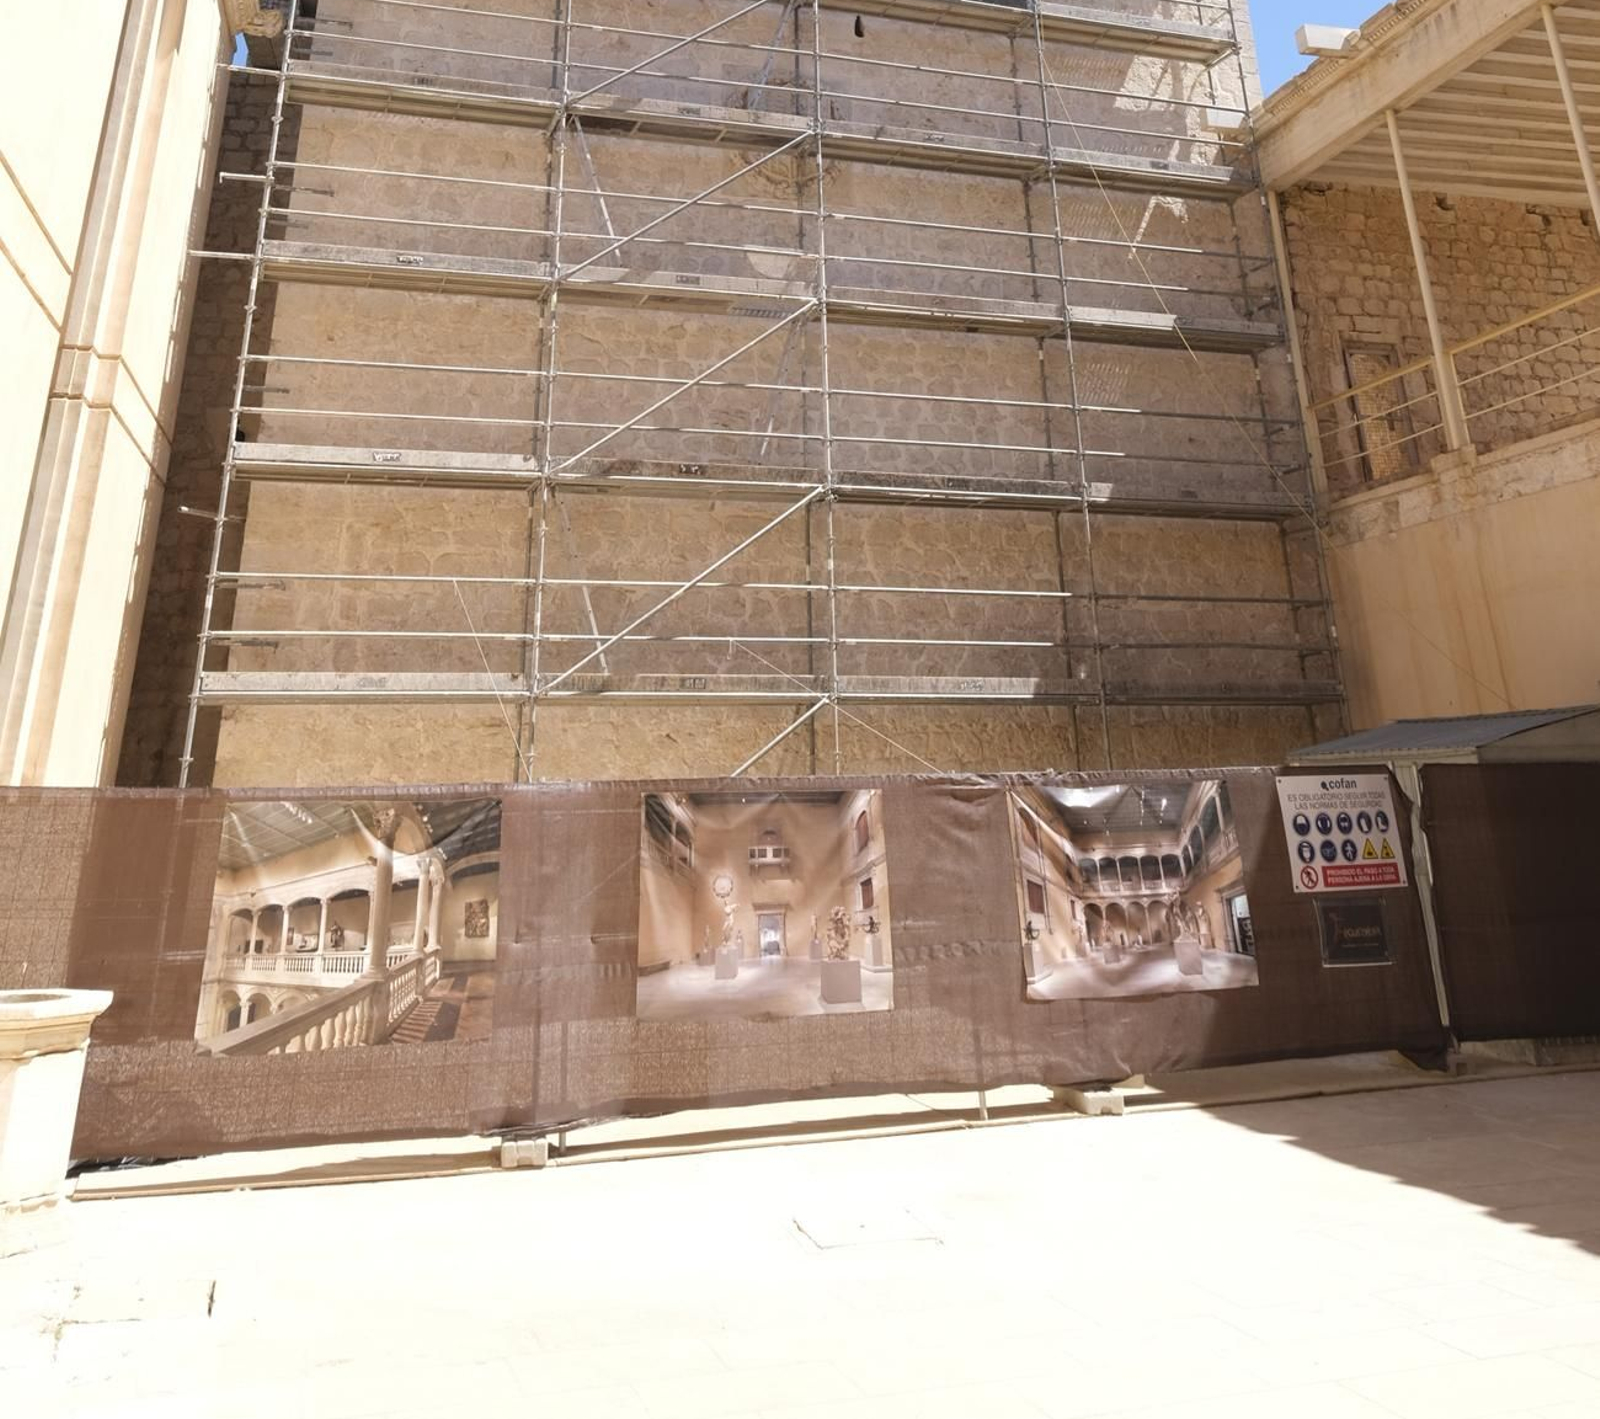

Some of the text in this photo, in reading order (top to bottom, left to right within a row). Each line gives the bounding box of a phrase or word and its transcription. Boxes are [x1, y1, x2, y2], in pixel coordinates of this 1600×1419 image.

[1328, 777, 1357, 790] cofan
[1287, 794, 1297, 802] ES
[1298, 793, 1343, 802] OBLIGATORIO
[1344, 792, 1367, 800] SEGUIR
[1294, 802, 1308, 810] LAS
[1309, 801, 1338, 809] NORMAS
[1339, 801, 1348, 809] DE
